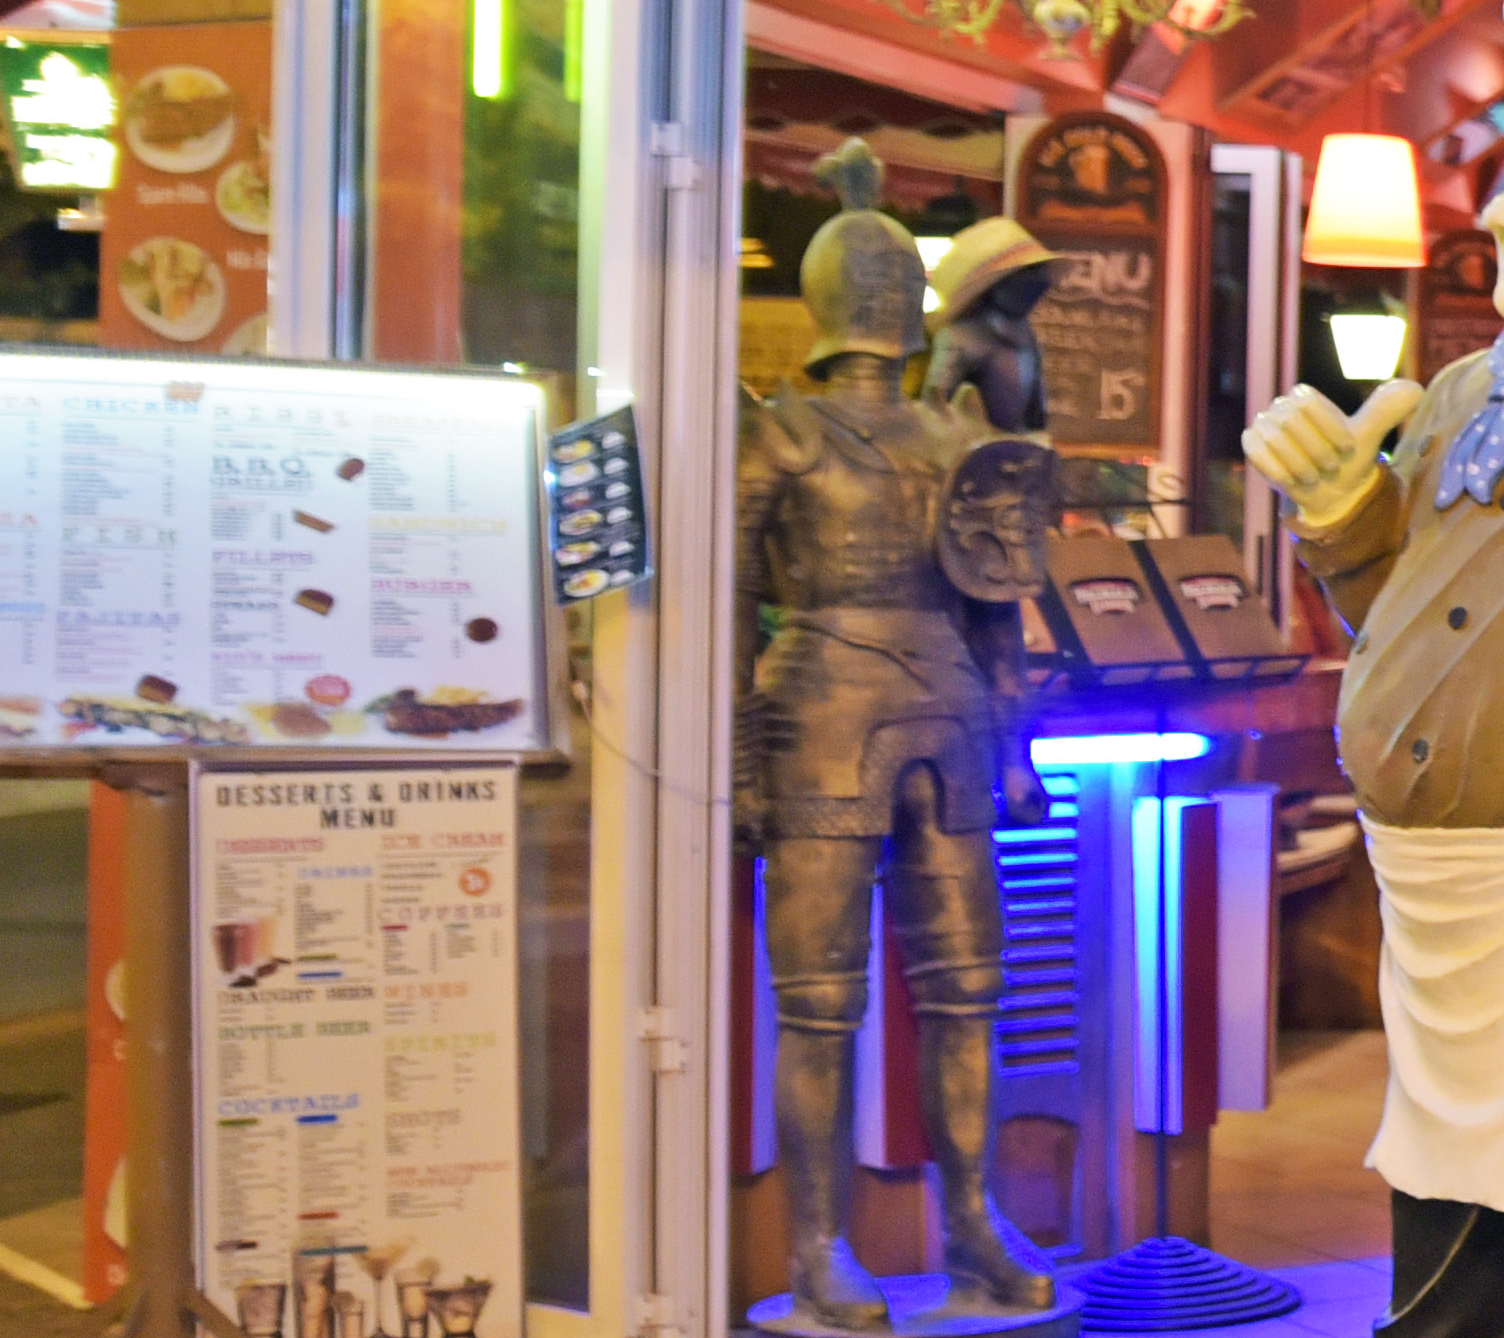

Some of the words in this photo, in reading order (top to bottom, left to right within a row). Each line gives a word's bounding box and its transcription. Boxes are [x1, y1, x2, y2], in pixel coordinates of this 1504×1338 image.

[216, 783, 353, 807] DESSERTS
[369, 783, 384, 803] &
[399, 780, 497, 802] DRINKS
[320, 808, 396, 829] MENU
